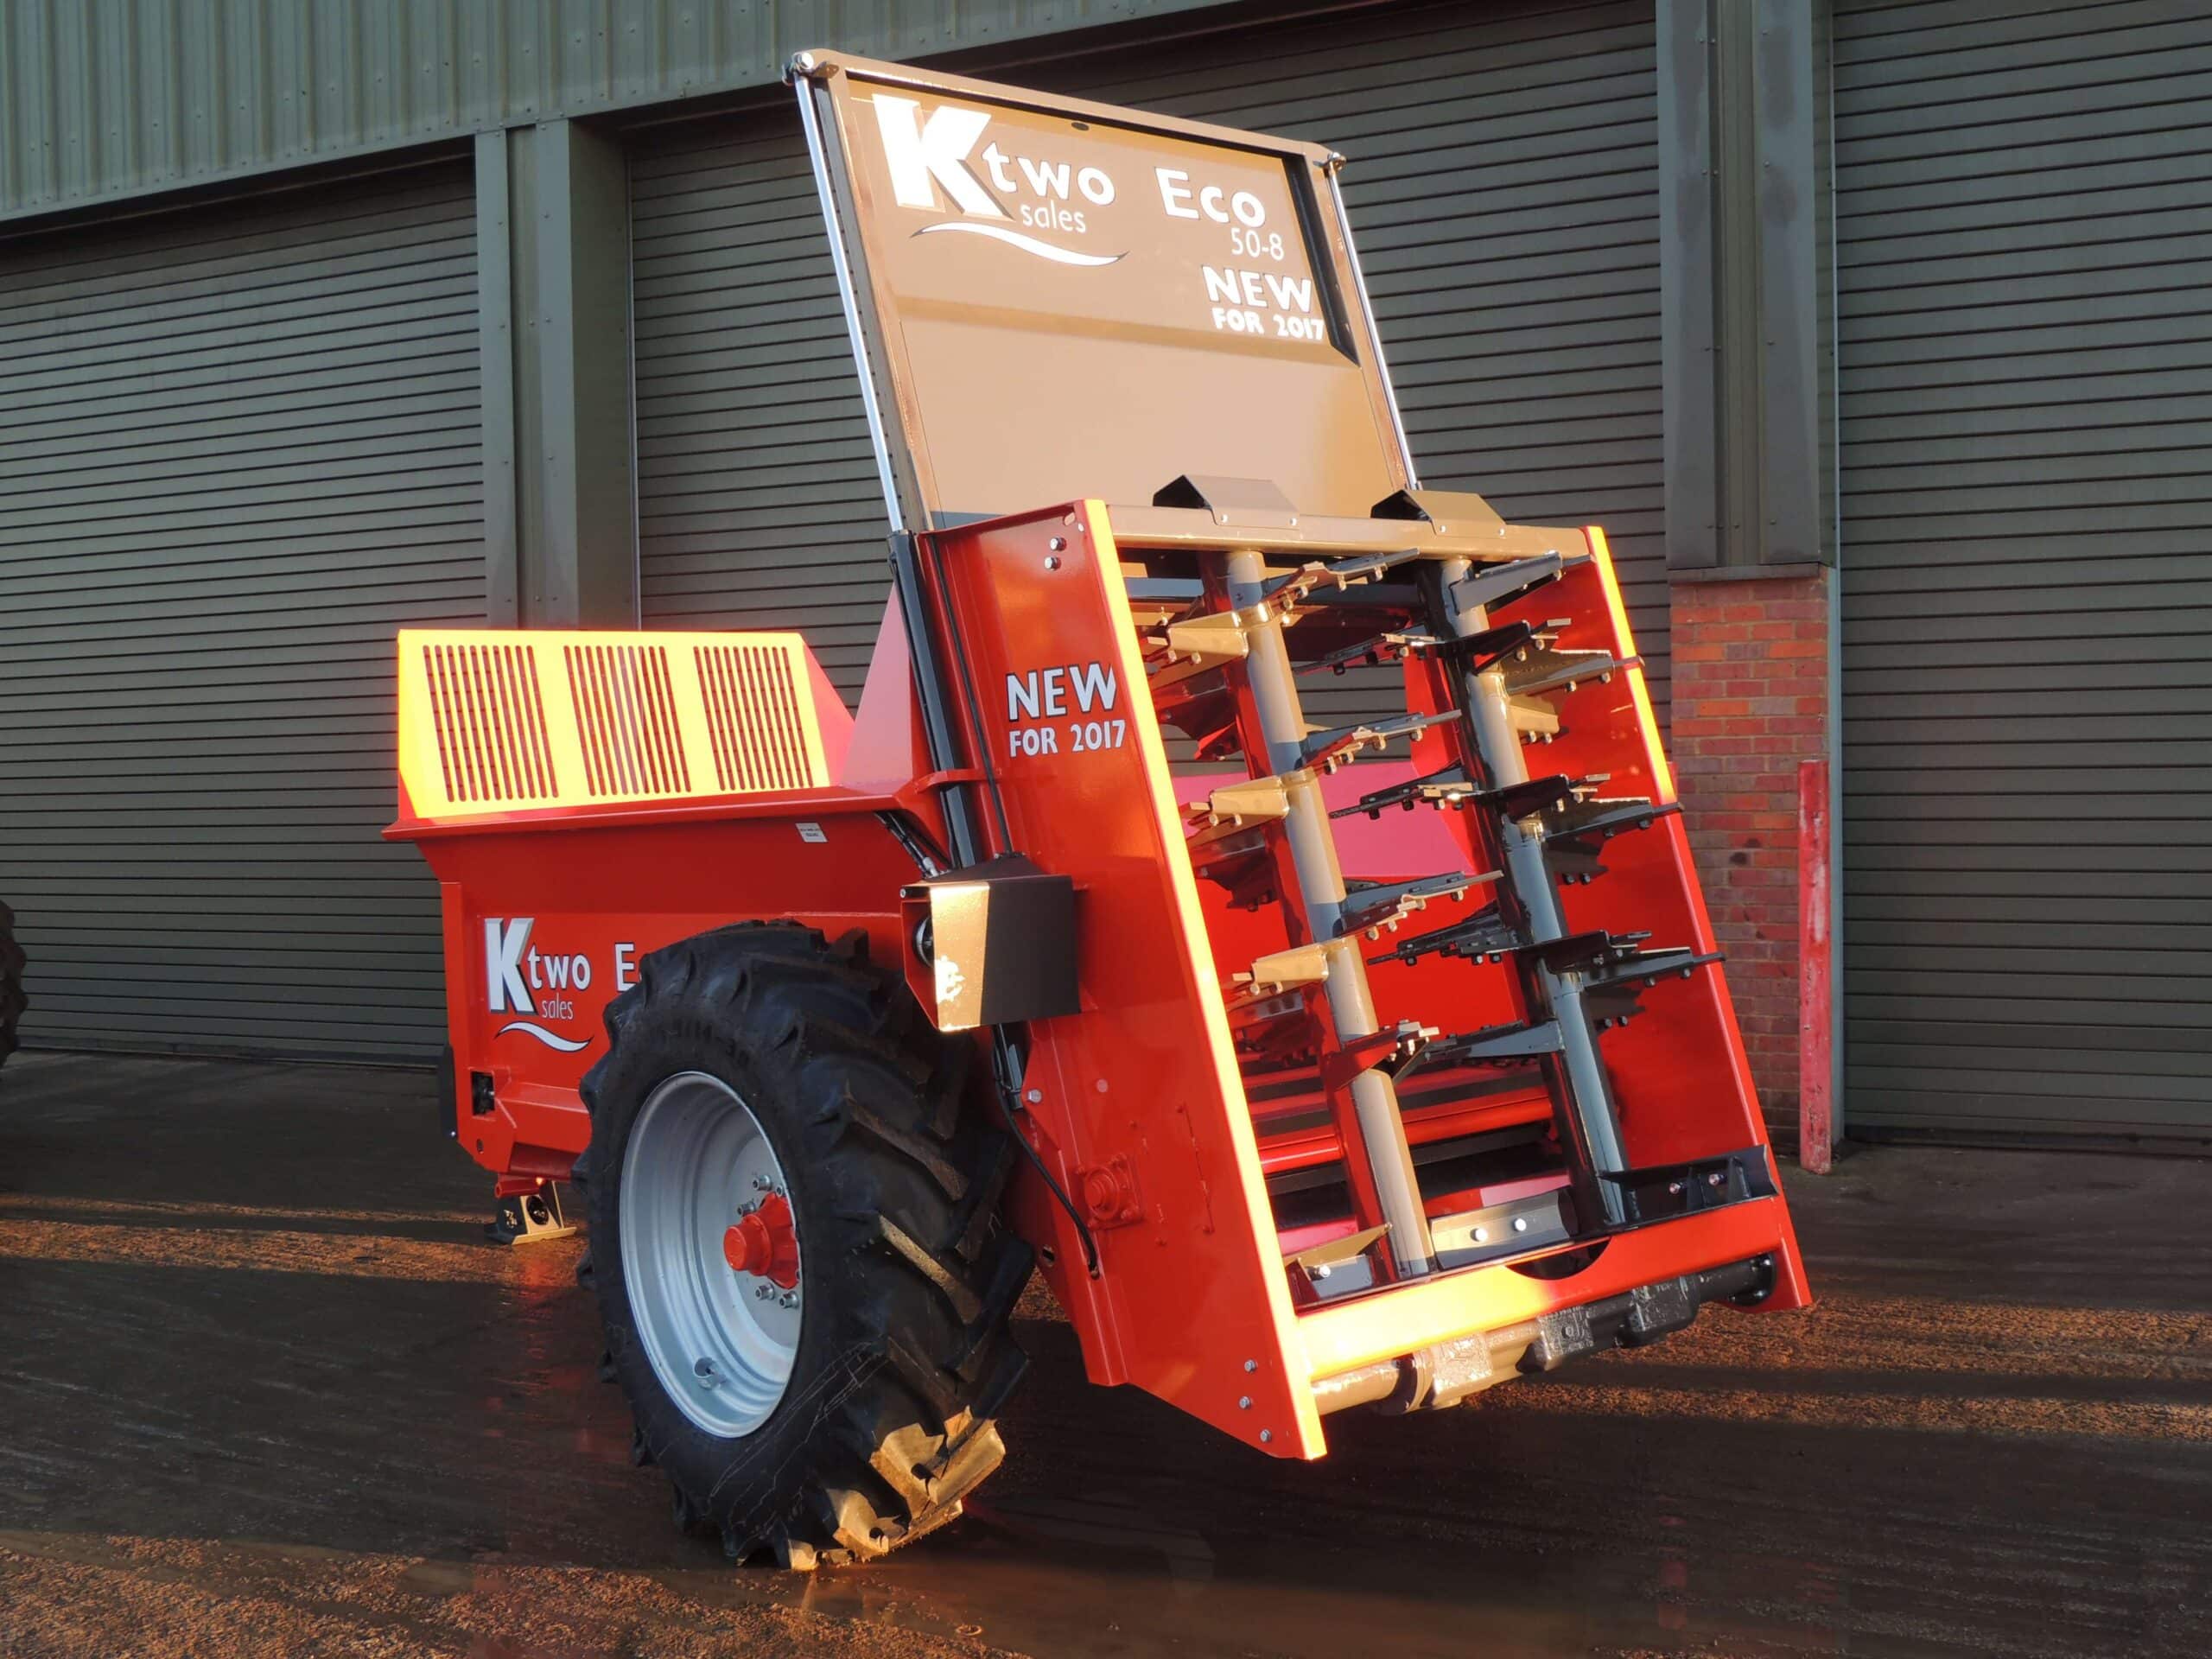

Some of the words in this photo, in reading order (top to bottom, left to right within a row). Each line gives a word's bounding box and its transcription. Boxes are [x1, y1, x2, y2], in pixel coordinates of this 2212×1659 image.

[1020, 200, 1086, 232] sales
[1154, 167, 1266, 227] Eco
[1230, 227, 1284, 261] 50-8
[1201, 264, 1312, 313] NEW
[1211, 308, 1264, 334] FOR
[1273, 314, 1325, 340] 2017
[1007, 661, 1117, 721] NEW
[1009, 727, 1058, 758] FOR
[1071, 719, 1127, 752] 2017
[614, 942, 642, 993] E
[541, 993, 574, 1020] sales
